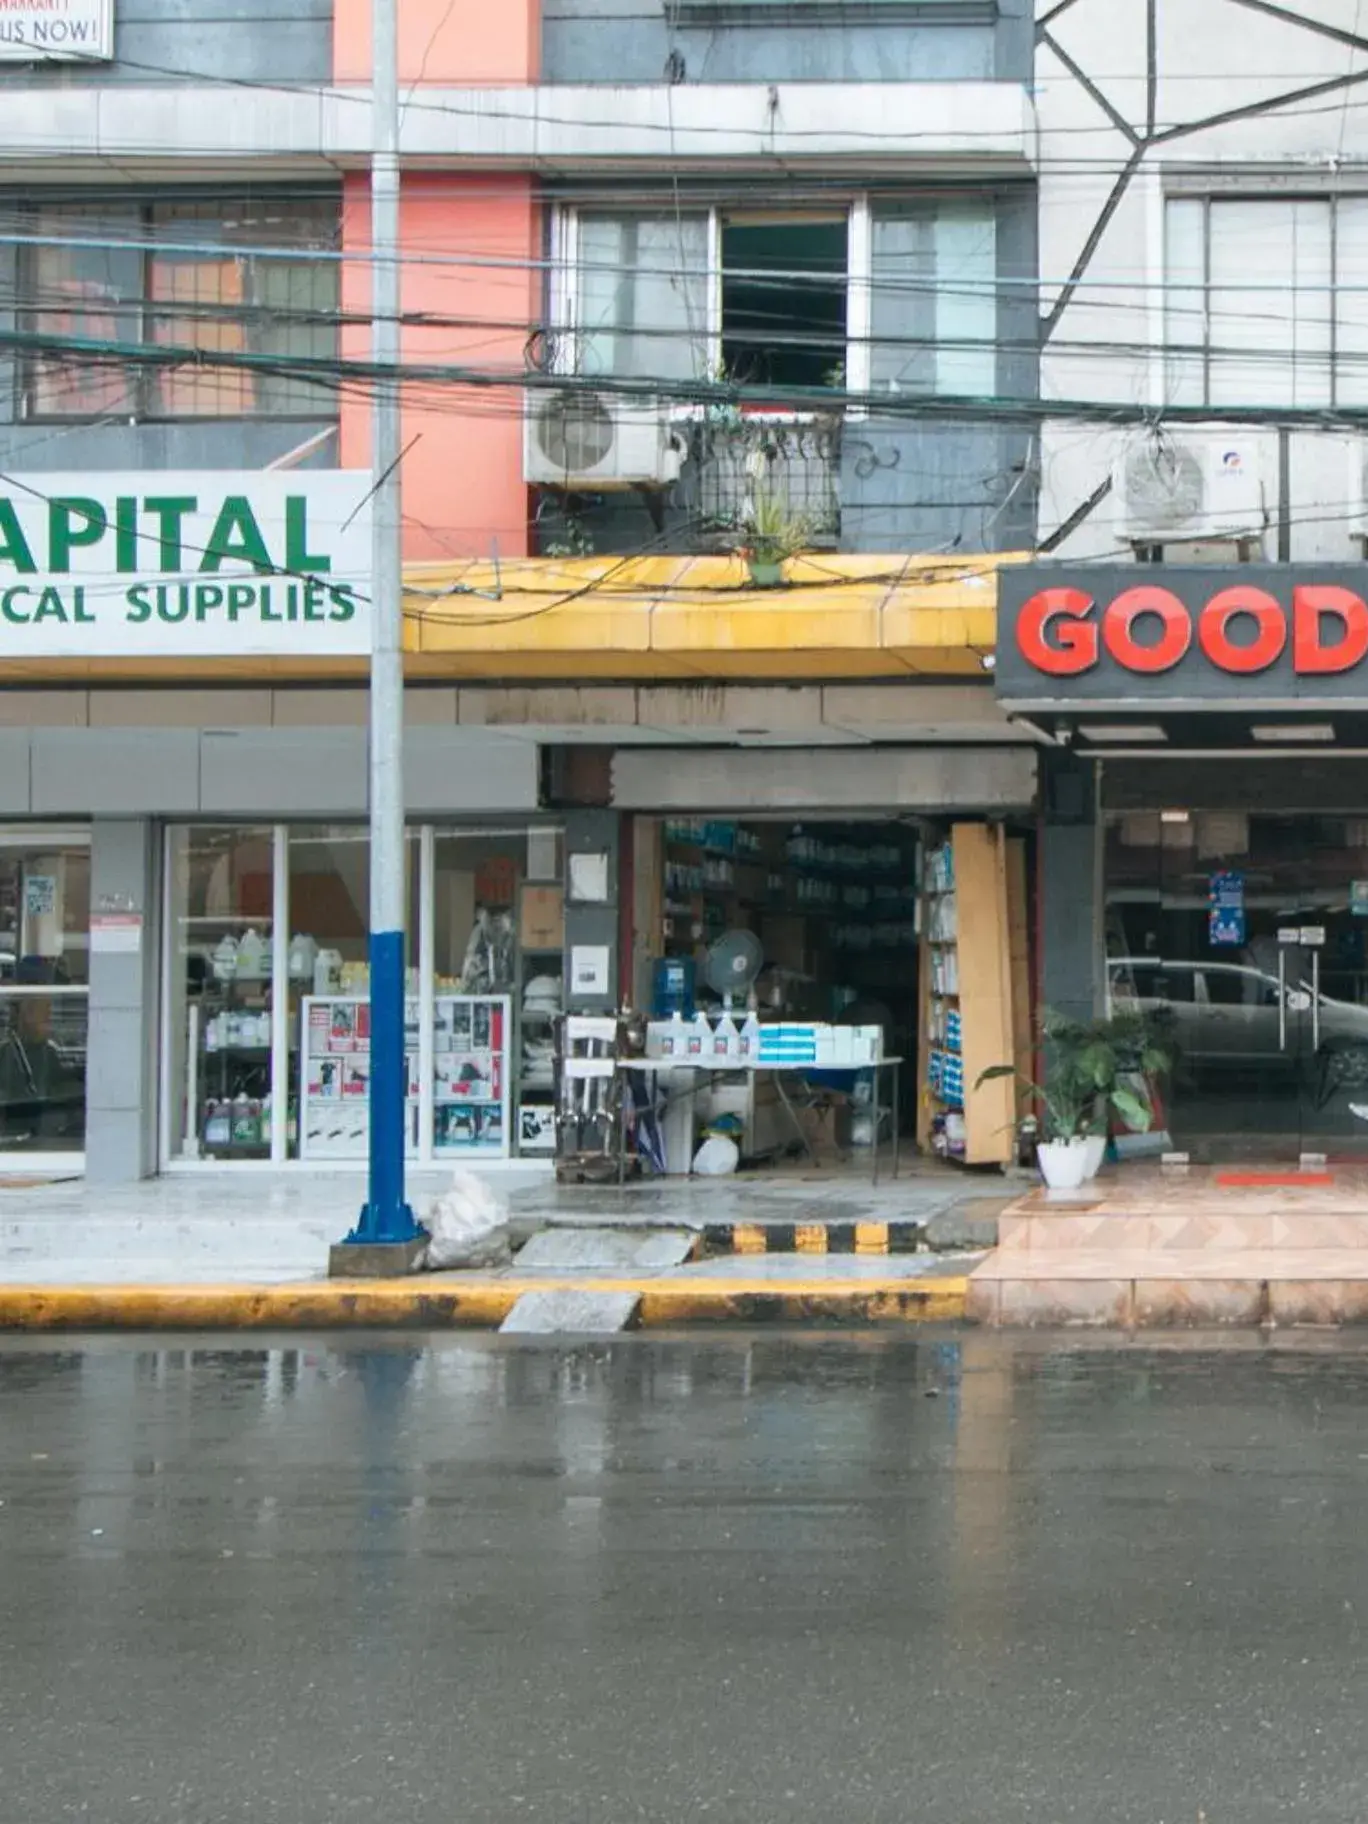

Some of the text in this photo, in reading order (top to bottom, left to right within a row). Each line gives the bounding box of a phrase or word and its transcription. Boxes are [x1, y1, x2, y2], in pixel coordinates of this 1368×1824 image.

[0, 19, 97, 42] US NOW!
[1, 583, 357, 624] CAL SUPPLIES
